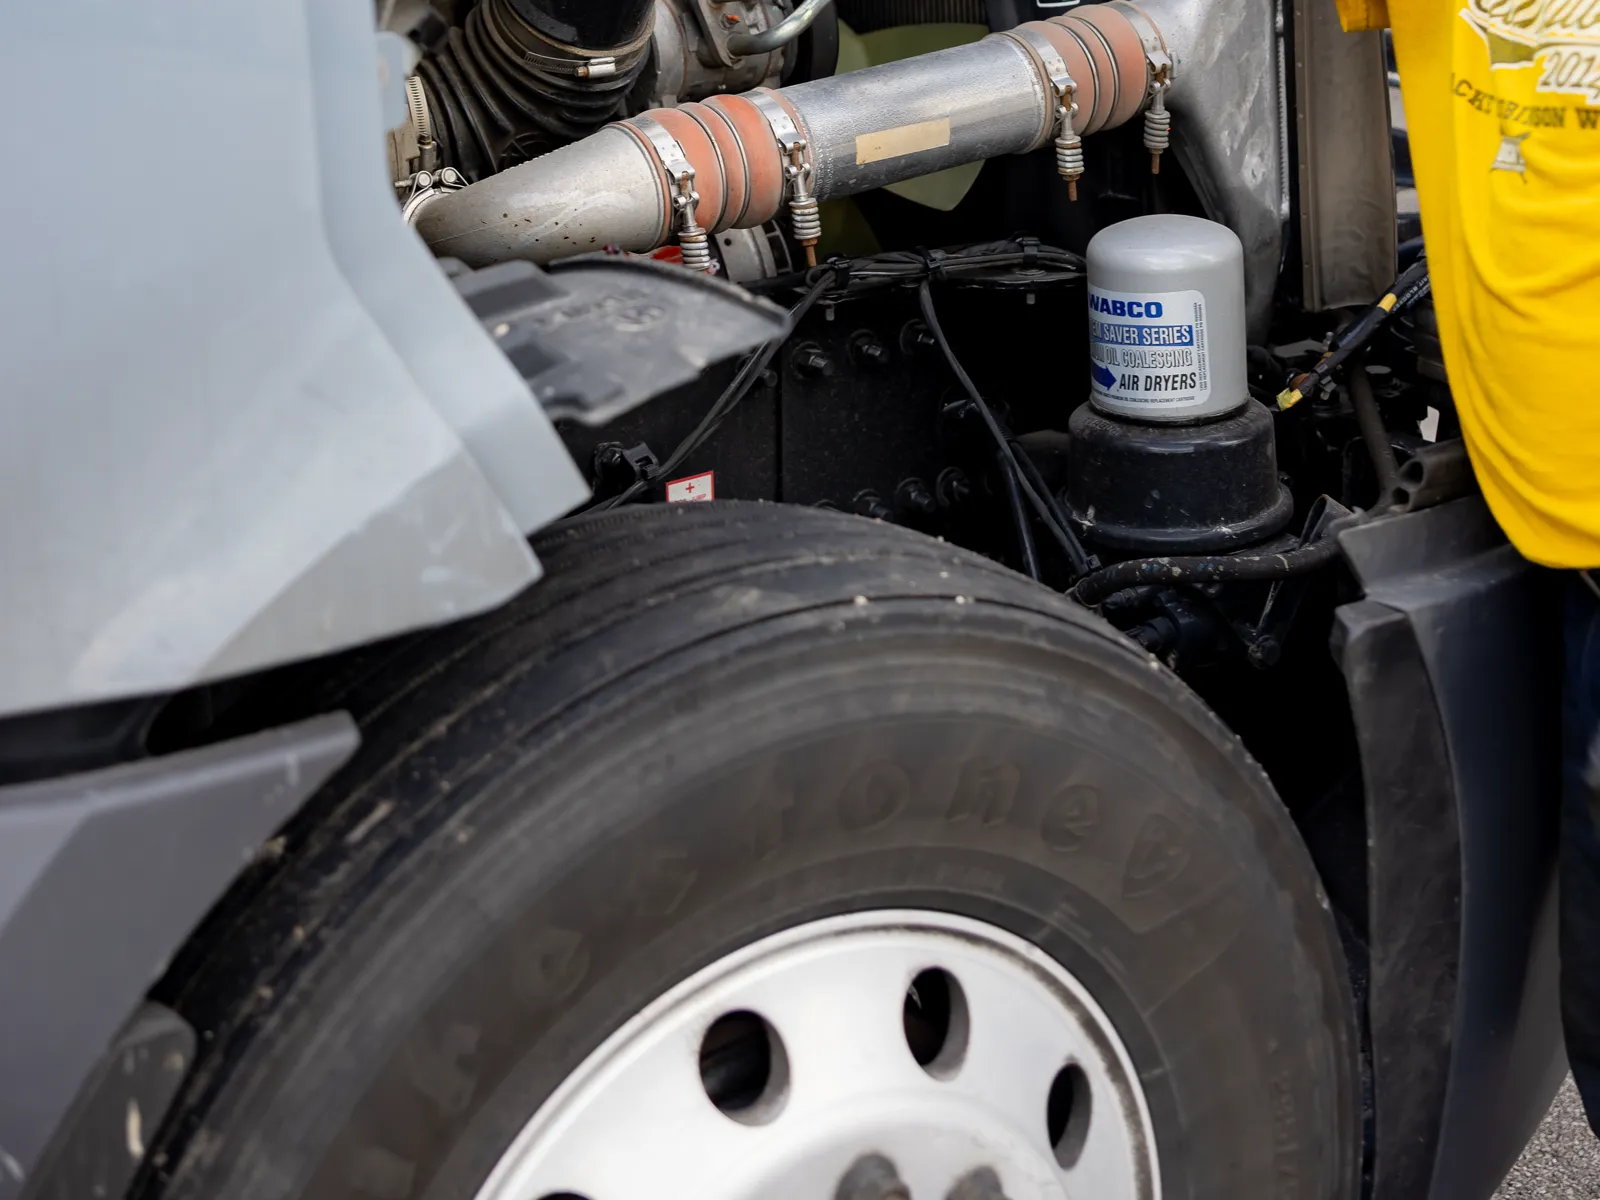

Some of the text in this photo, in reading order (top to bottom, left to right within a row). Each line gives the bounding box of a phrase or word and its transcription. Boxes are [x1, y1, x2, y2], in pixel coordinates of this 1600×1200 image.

[1103, 324, 1139, 346] SAVER
[1142, 325, 1191, 346] SERIES
[1106, 346, 1120, 367] OIL
[1121, 348, 1193, 369] COALESCING
[1119, 373, 1139, 391] AIR
[1144, 372, 1197, 392] DRYERS
